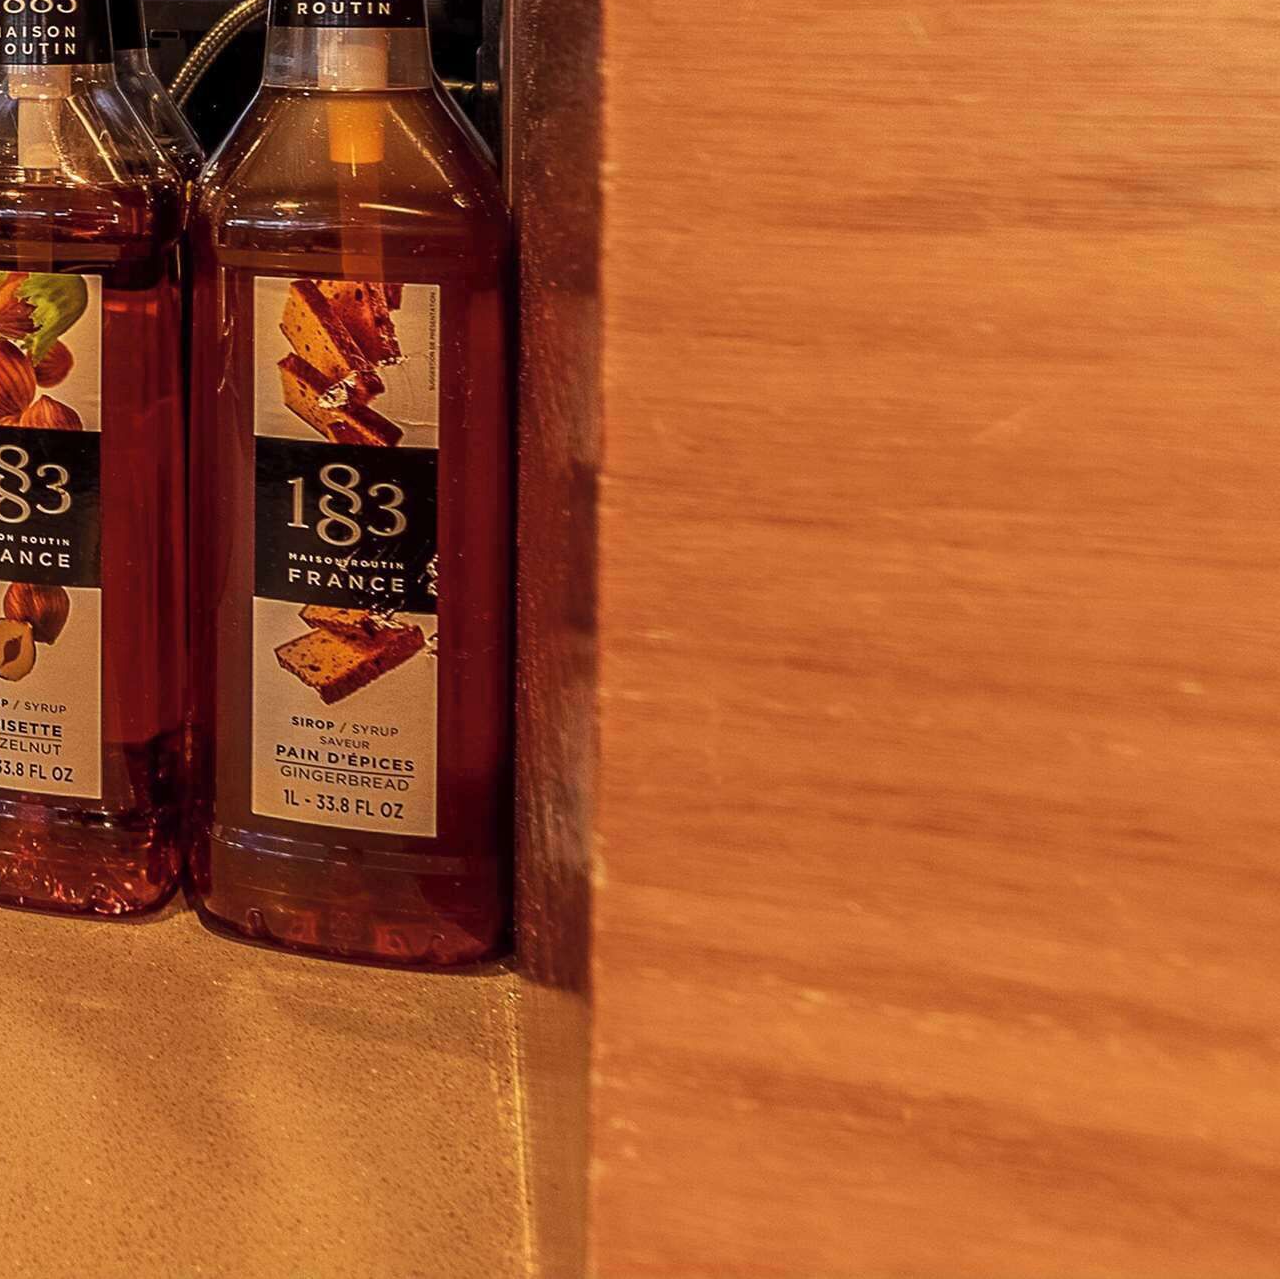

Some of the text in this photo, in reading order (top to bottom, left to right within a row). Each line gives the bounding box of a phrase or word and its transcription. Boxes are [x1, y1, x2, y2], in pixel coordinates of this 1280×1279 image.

[298, 2, 390, 14] ROUTIN
[287, 464, 406, 546] 1883
[21, 536, 70, 546] ROUTIN
[351, 560, 404, 569] ROUTIN
[289, 568, 404, 592] FRANCE
[25, 702, 66, 713] SYRUP
[292, 716, 398, 736] SIROP SYRUP
[320, 736, 369, 749] SAVEUR
[277, 745, 414, 771] PAIN D'ÉPICES
[30, 764, 46, 779] FL
[53, 767, 73, 782] OZ
[281, 765, 409, 791] GINGERBREAD
[284, 789, 403, 819] 1L 33.8 FL OZ
